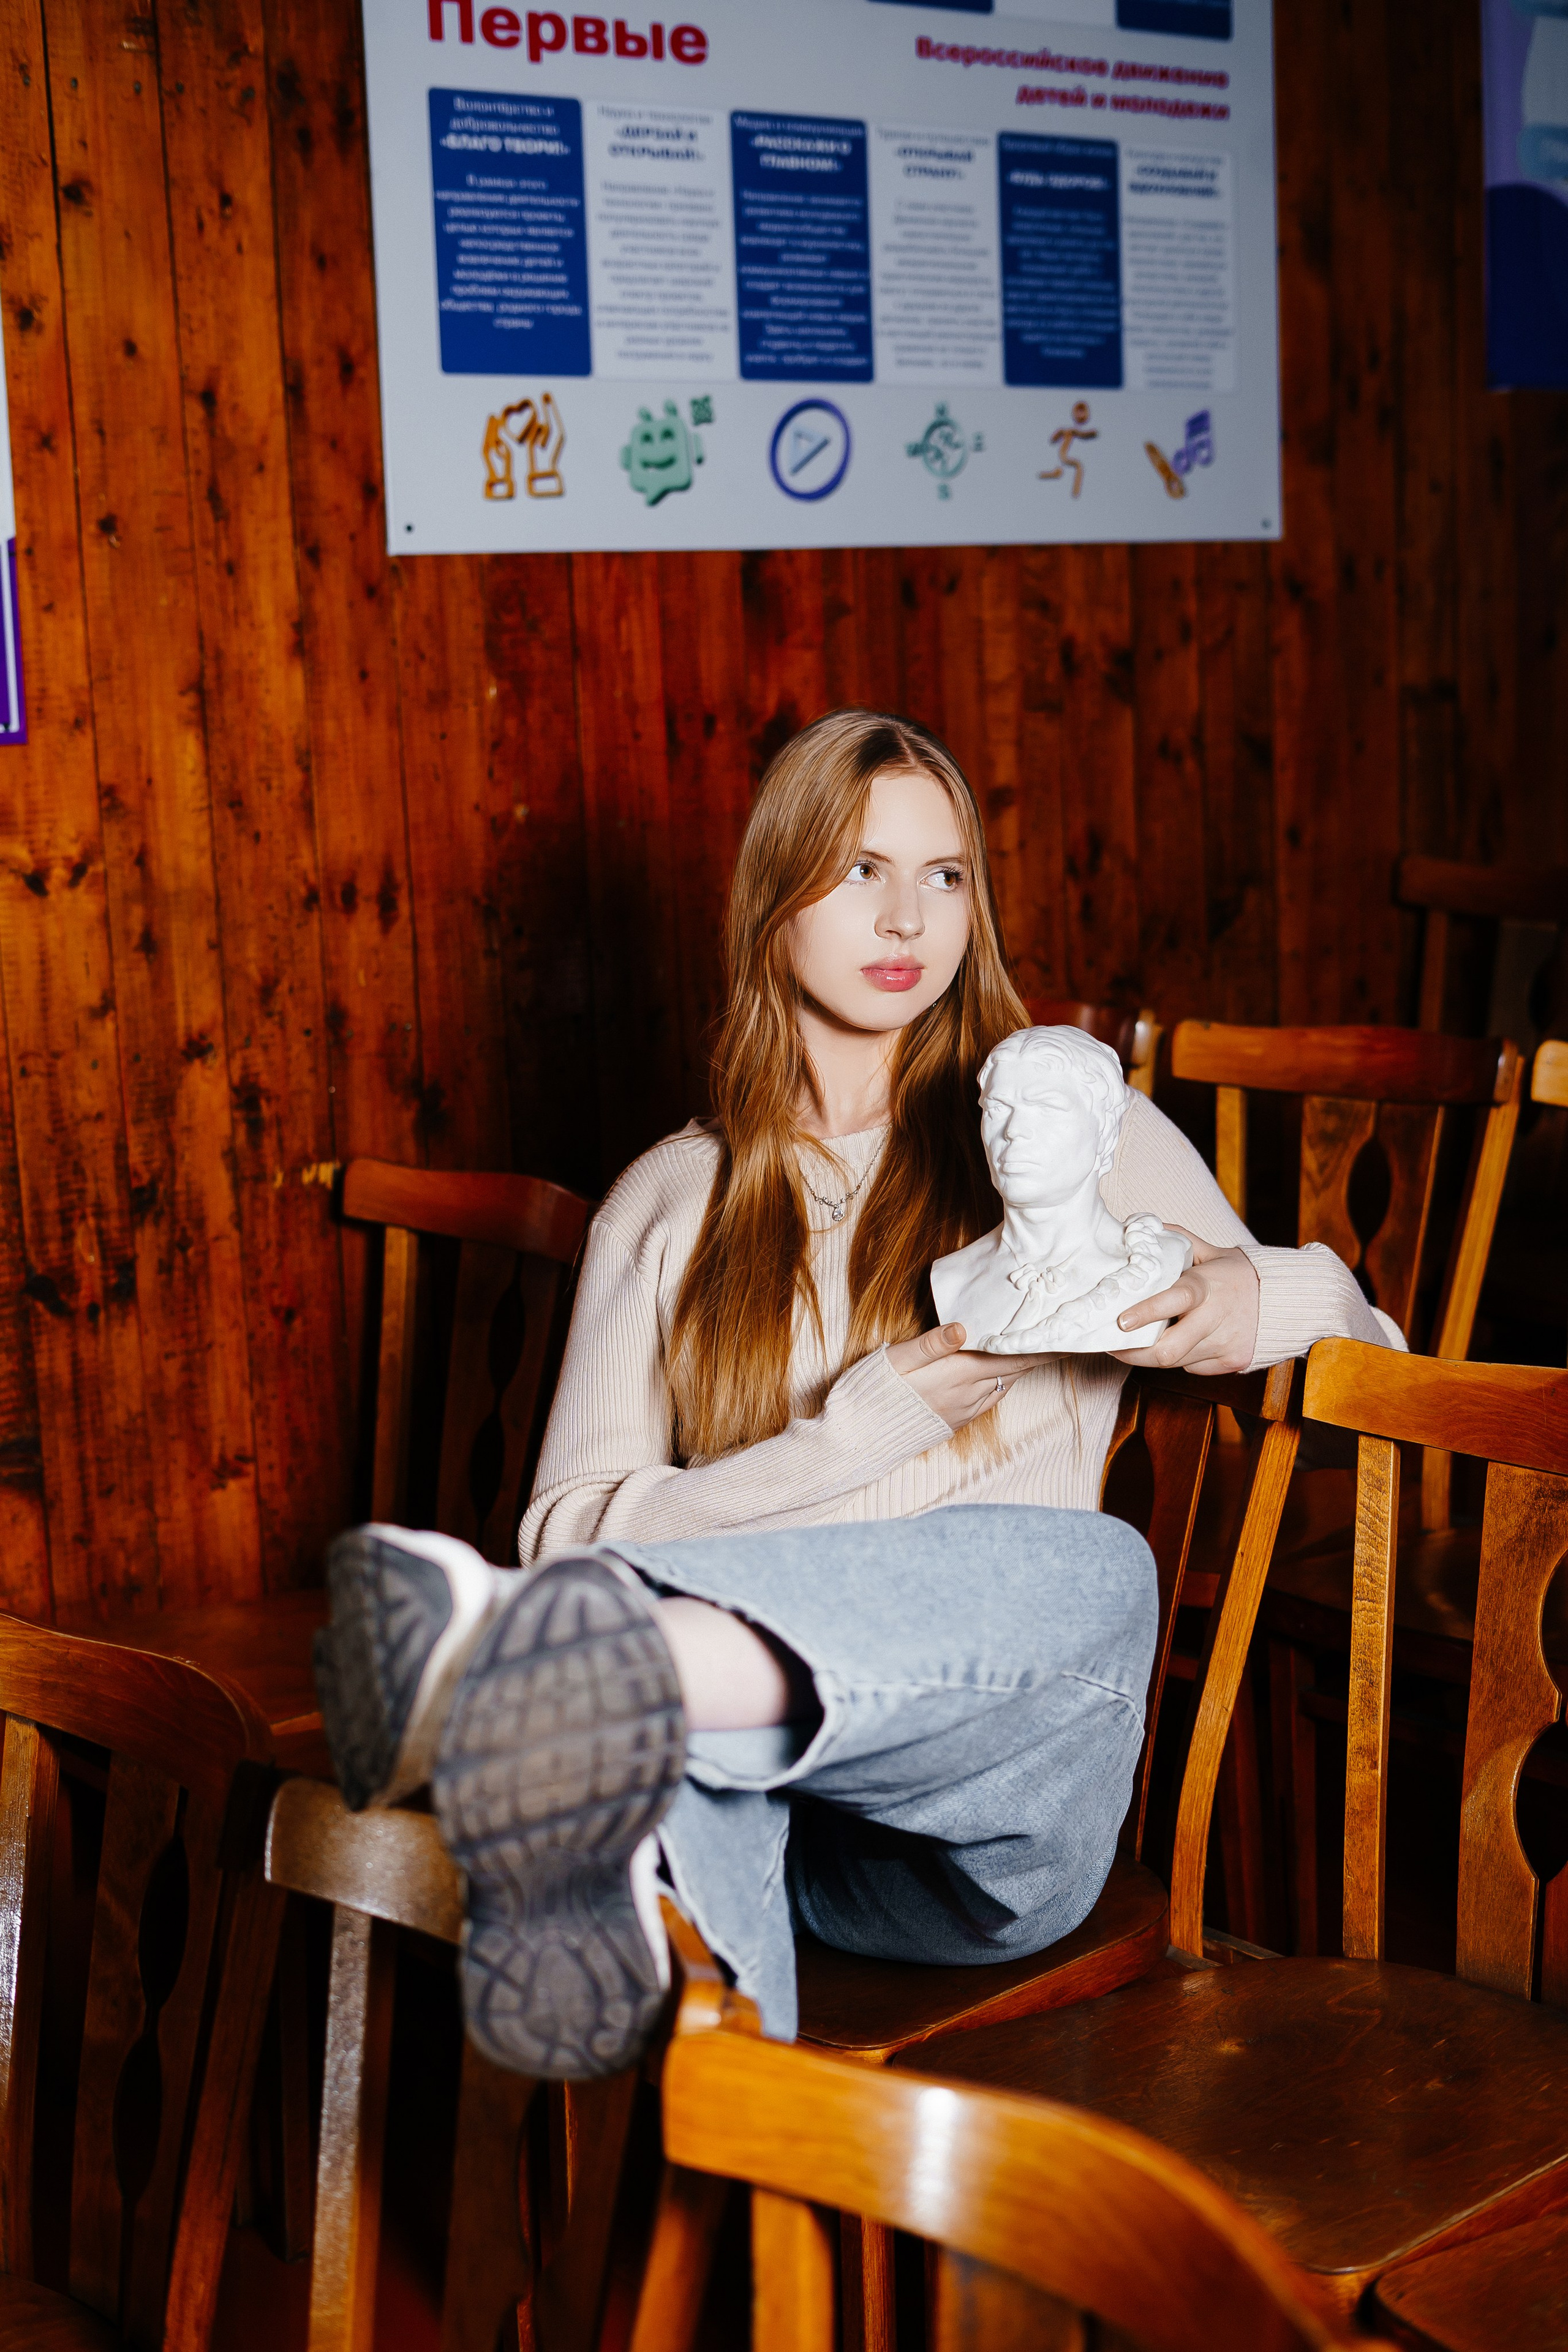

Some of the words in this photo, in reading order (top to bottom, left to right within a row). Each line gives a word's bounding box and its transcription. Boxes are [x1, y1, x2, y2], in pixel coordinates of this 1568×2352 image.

[428, 0, 709, 66] Первые
[915, 35, 1109, 77] Всероссийское
[1112, 60, 1229, 89] движение
[1016, 85, 1087, 107] детей
[1091, 92, 1107, 108] и
